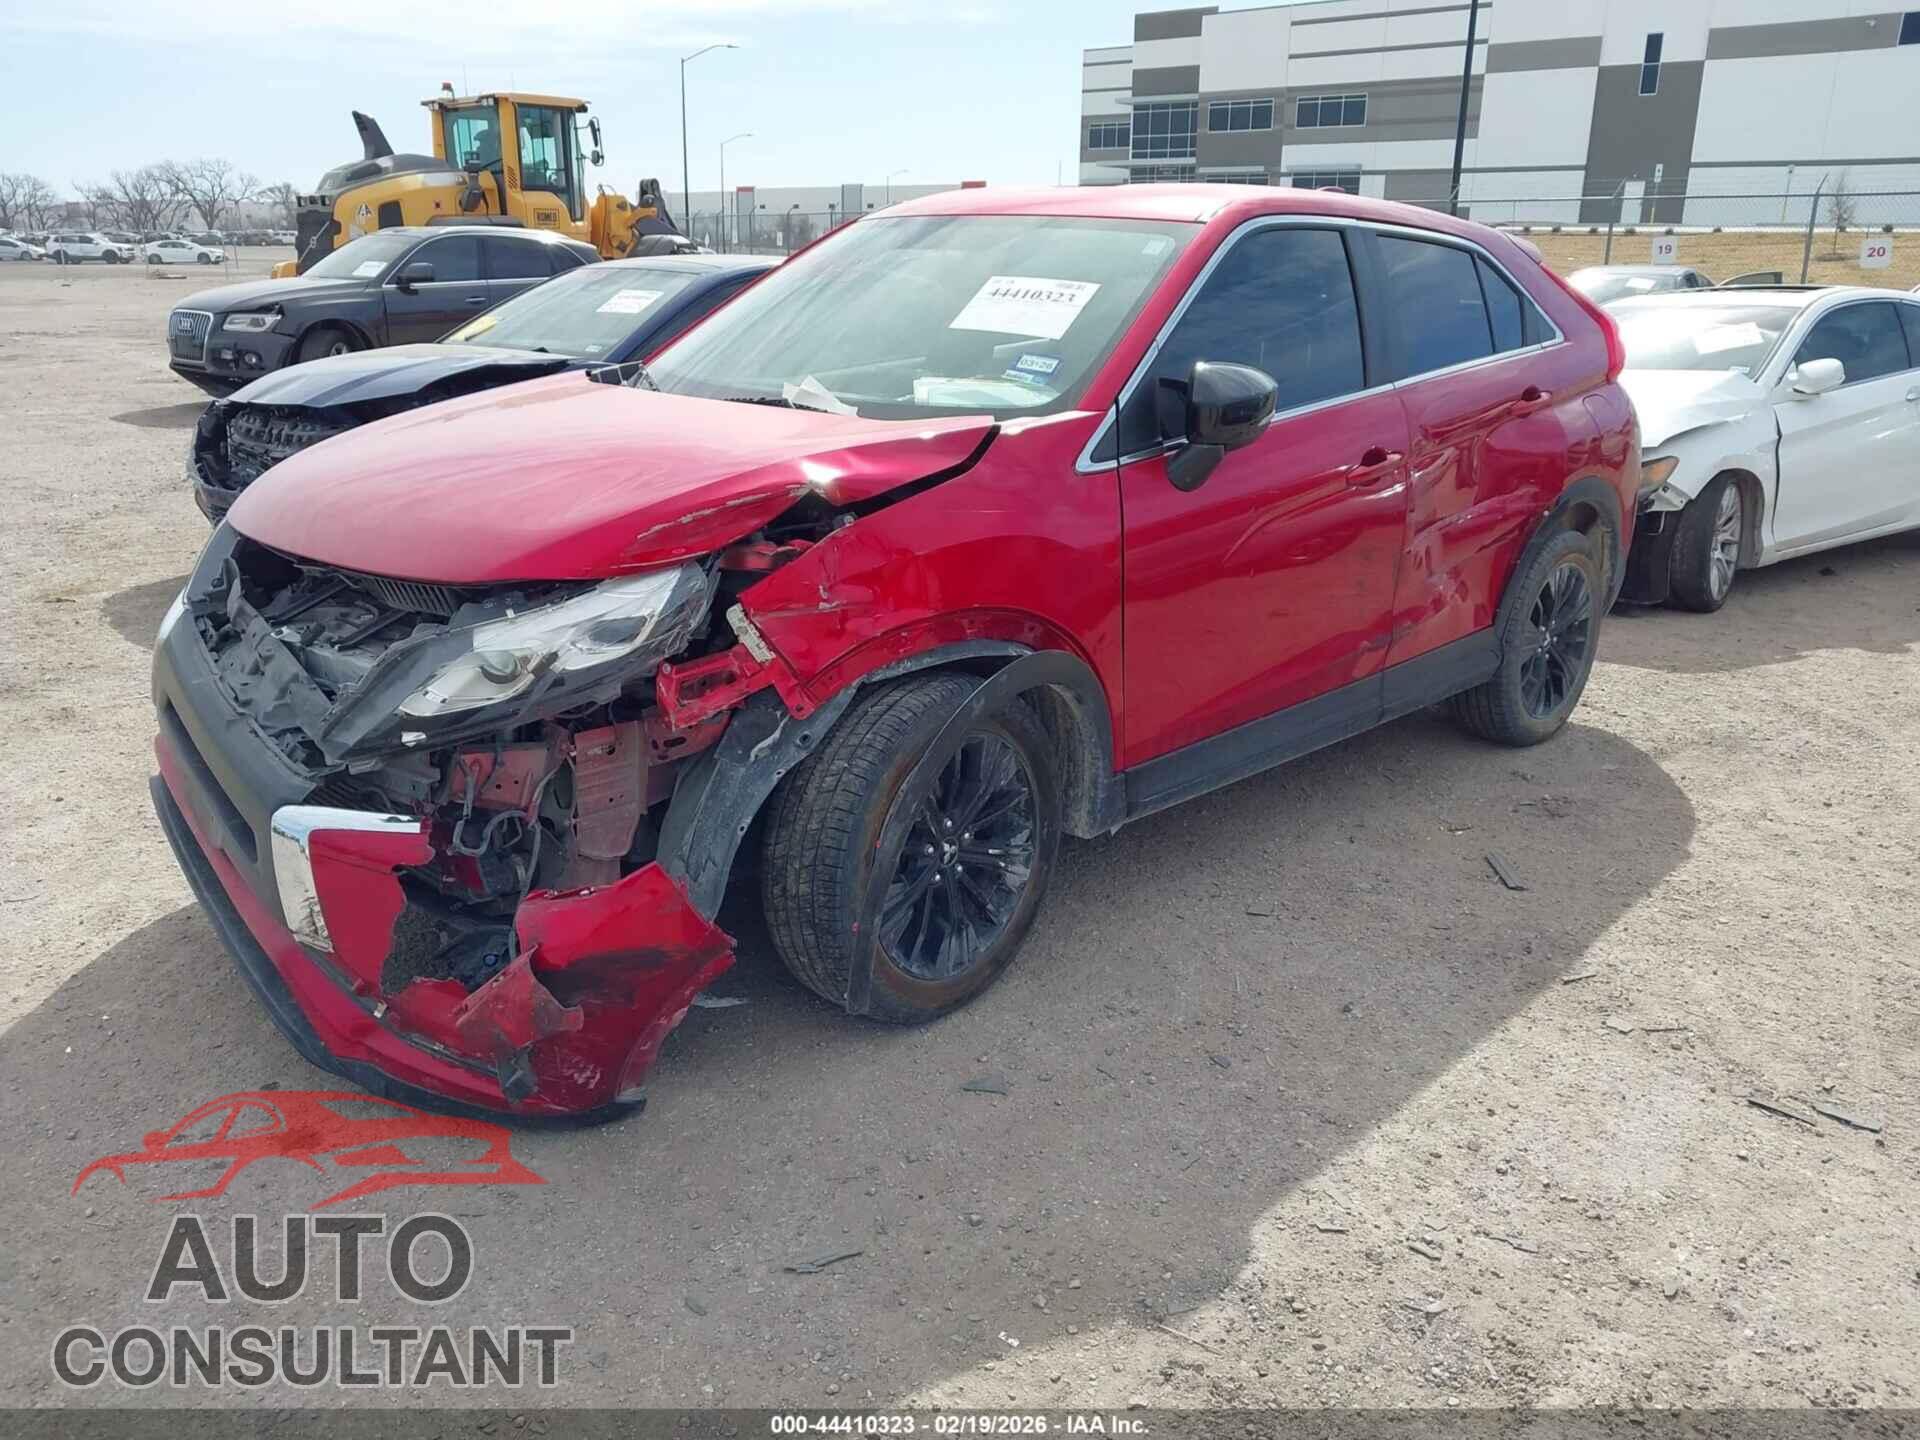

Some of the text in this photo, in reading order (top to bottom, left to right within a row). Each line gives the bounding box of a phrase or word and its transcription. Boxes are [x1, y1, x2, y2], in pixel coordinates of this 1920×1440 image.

[1658, 244, 1673, 256] 19
[1867, 246, 1886, 258] 20
[990, 287, 1076, 302] 44410323
